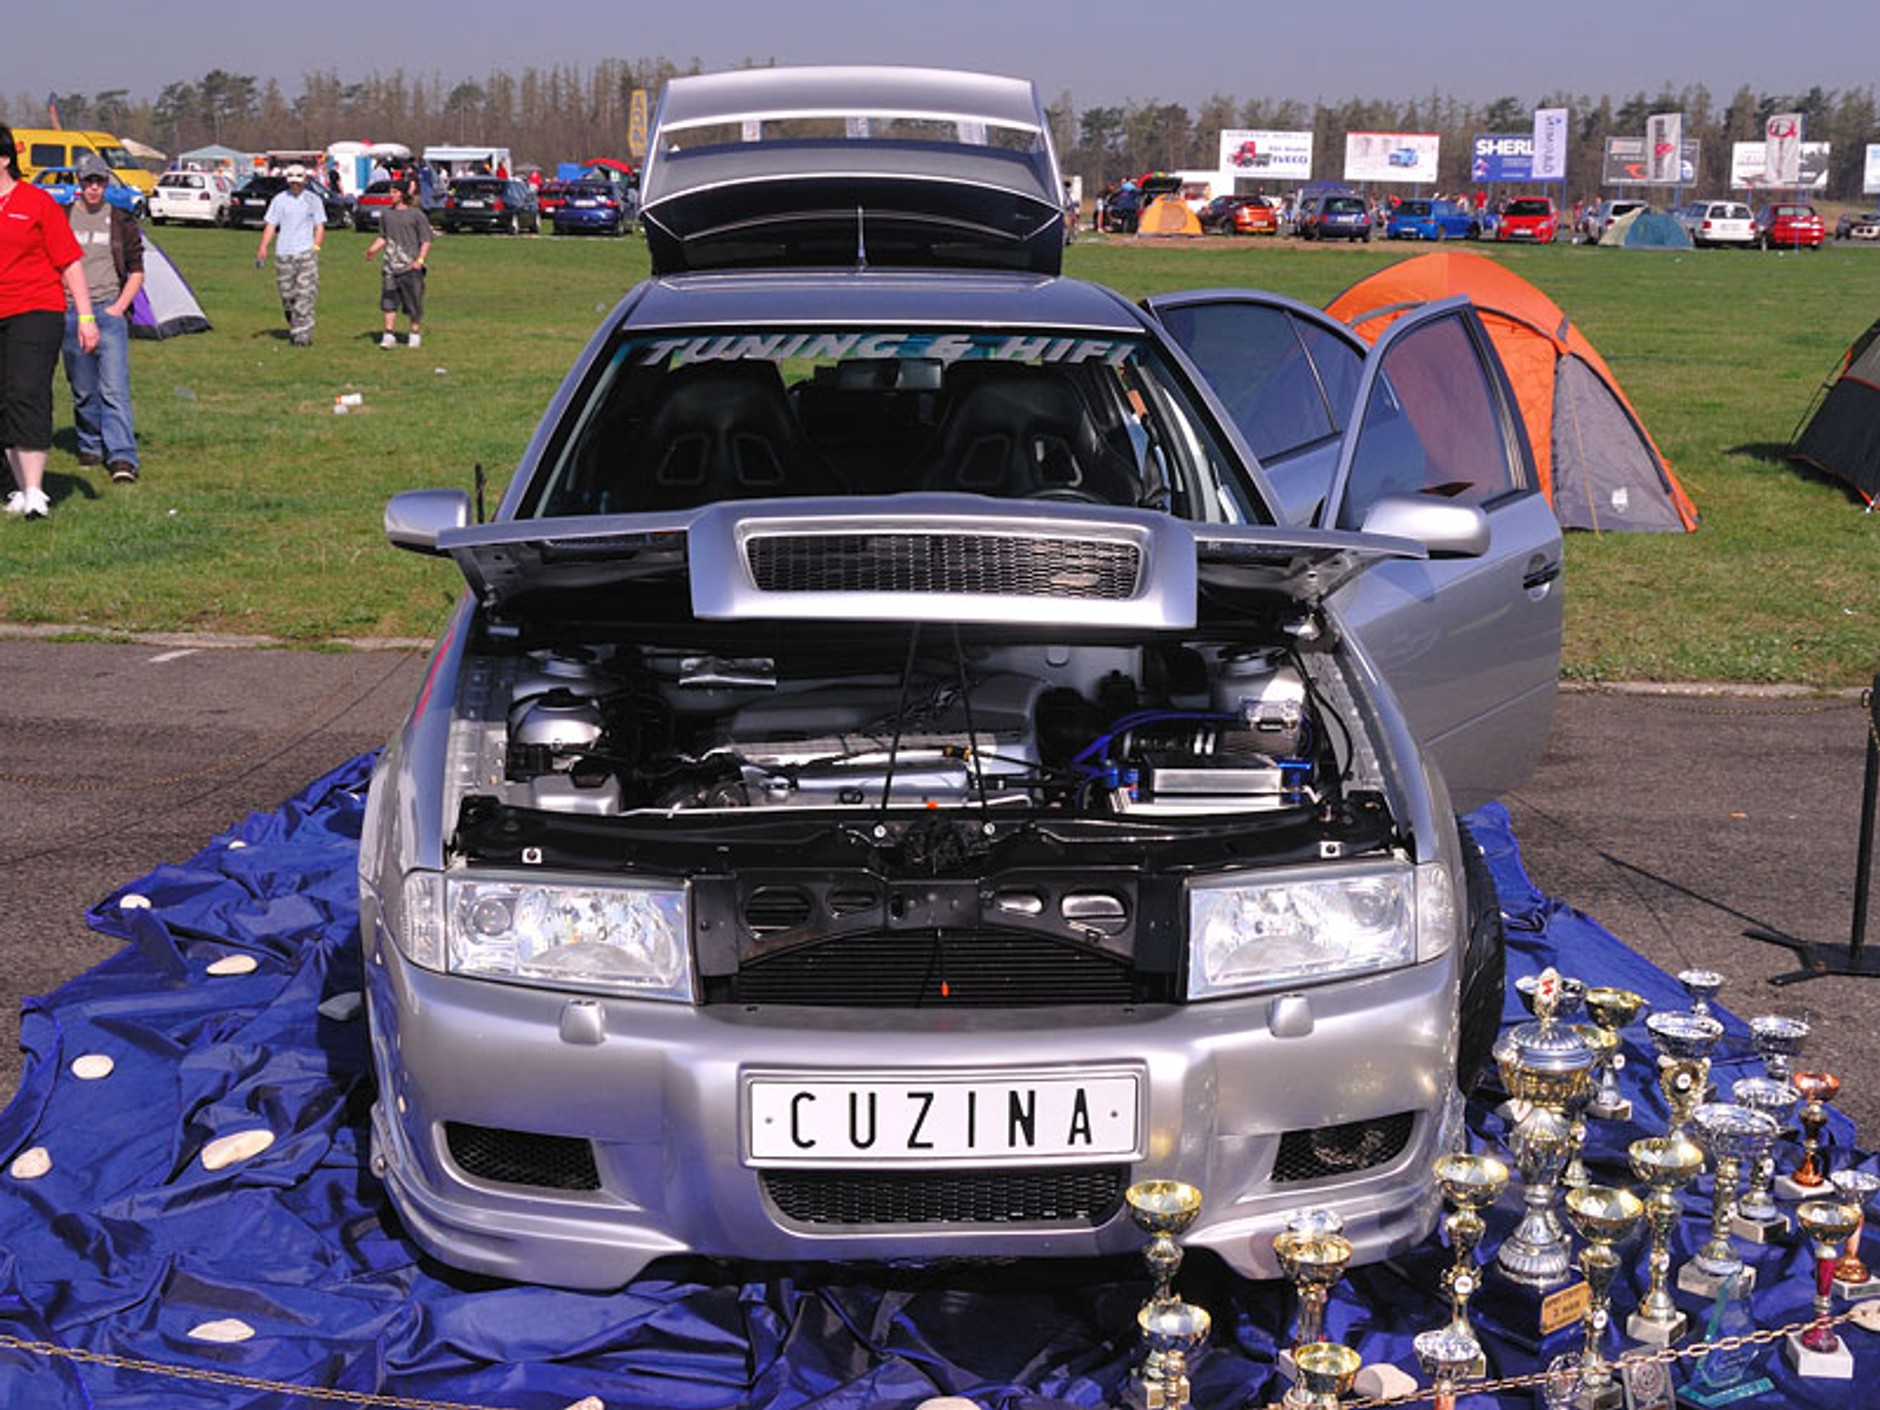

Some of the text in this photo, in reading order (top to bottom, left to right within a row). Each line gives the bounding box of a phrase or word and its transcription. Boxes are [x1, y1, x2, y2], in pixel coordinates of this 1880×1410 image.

[641, 333, 909, 365] TUNING
[996, 336, 1135, 365] HIFI
[790, 1088, 1093, 1149] CUZINA
